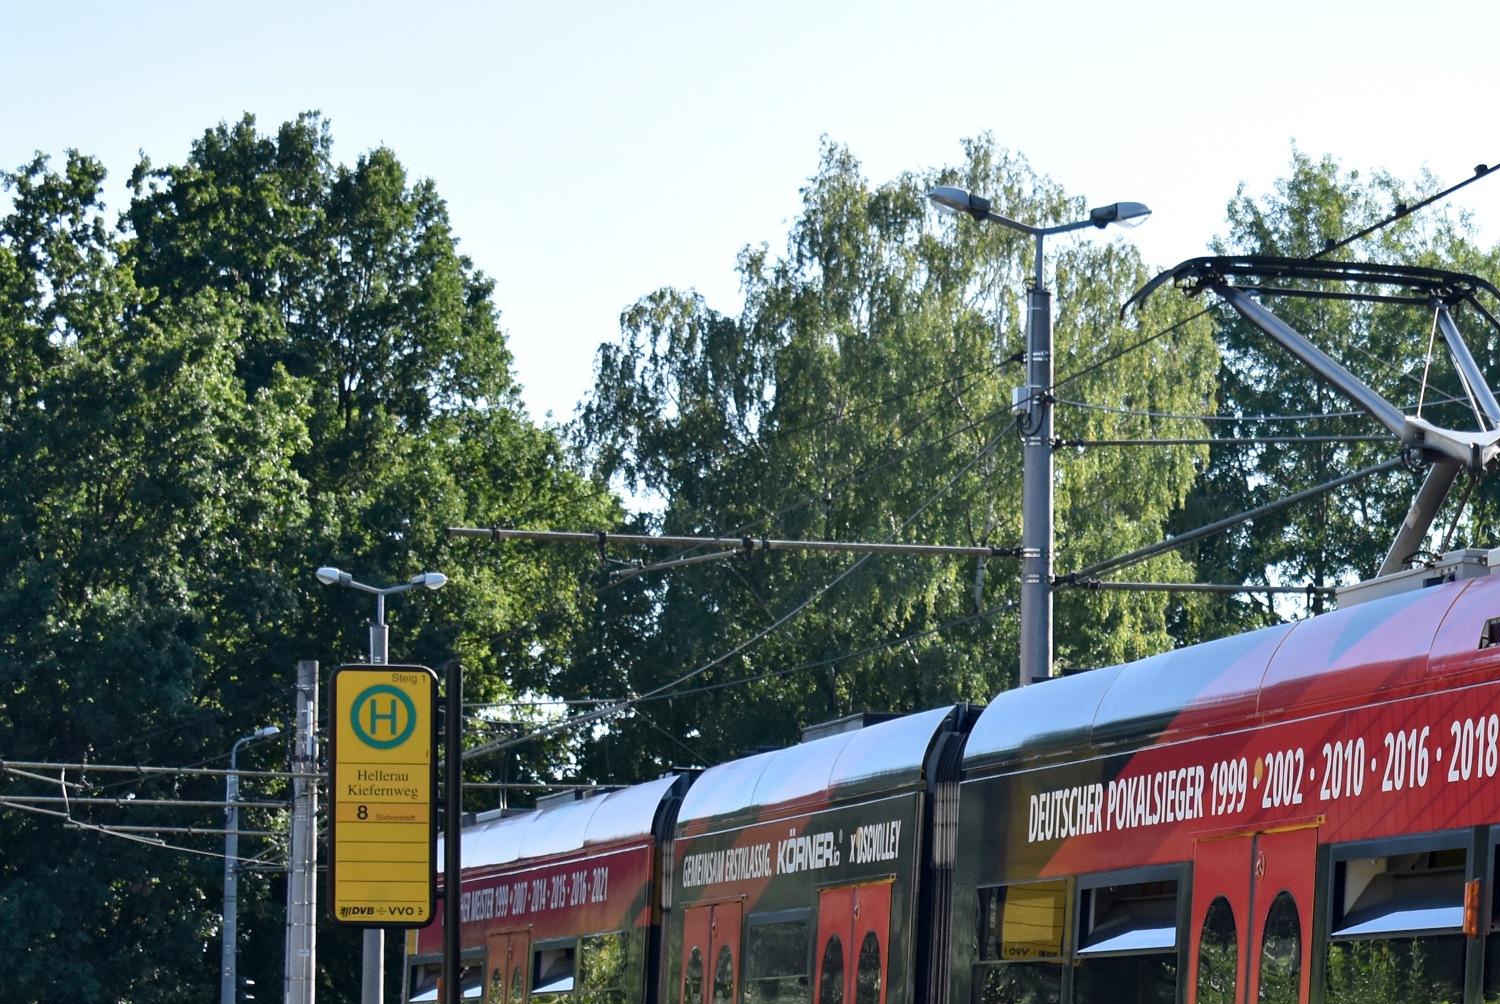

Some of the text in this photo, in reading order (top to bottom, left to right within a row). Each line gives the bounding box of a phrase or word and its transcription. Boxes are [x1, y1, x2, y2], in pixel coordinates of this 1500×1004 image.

[392, 673, 418, 685] Steig
[370, 698, 397, 736] H
[357, 769, 409, 782] Hellerau
[1027, 788, 1104, 844] DEUTSCHER
[1106, 764, 1205, 831] POKALSIEGER
[1210, 757, 1249, 816] 1999
[1261, 748, 1305, 809] 2002
[1319, 737, 1365, 801] 2010
[1381, 725, 1430, 792] 2016
[1447, 713, 1500, 783] 2018
[348, 784, 418, 800] Kiefernweg
[357, 805, 369, 820] 8
[683, 850, 725, 888] GEMEINSAM
[725, 842, 772, 882] ERSTKLASSIG.
[857, 820, 902, 864] DSCVOLLEY
[471, 887, 495, 922] MEISTER
[495, 884, 509, 918] 1999
[512, 880, 528, 915] 2007
[531, 877, 547, 913] 2014
[550, 873, 567, 910] 2015
[570, 869, 587, 906] 2016
[591, 866, 609, 903] 2021
[352, 906, 414, 916] DVB VVO
